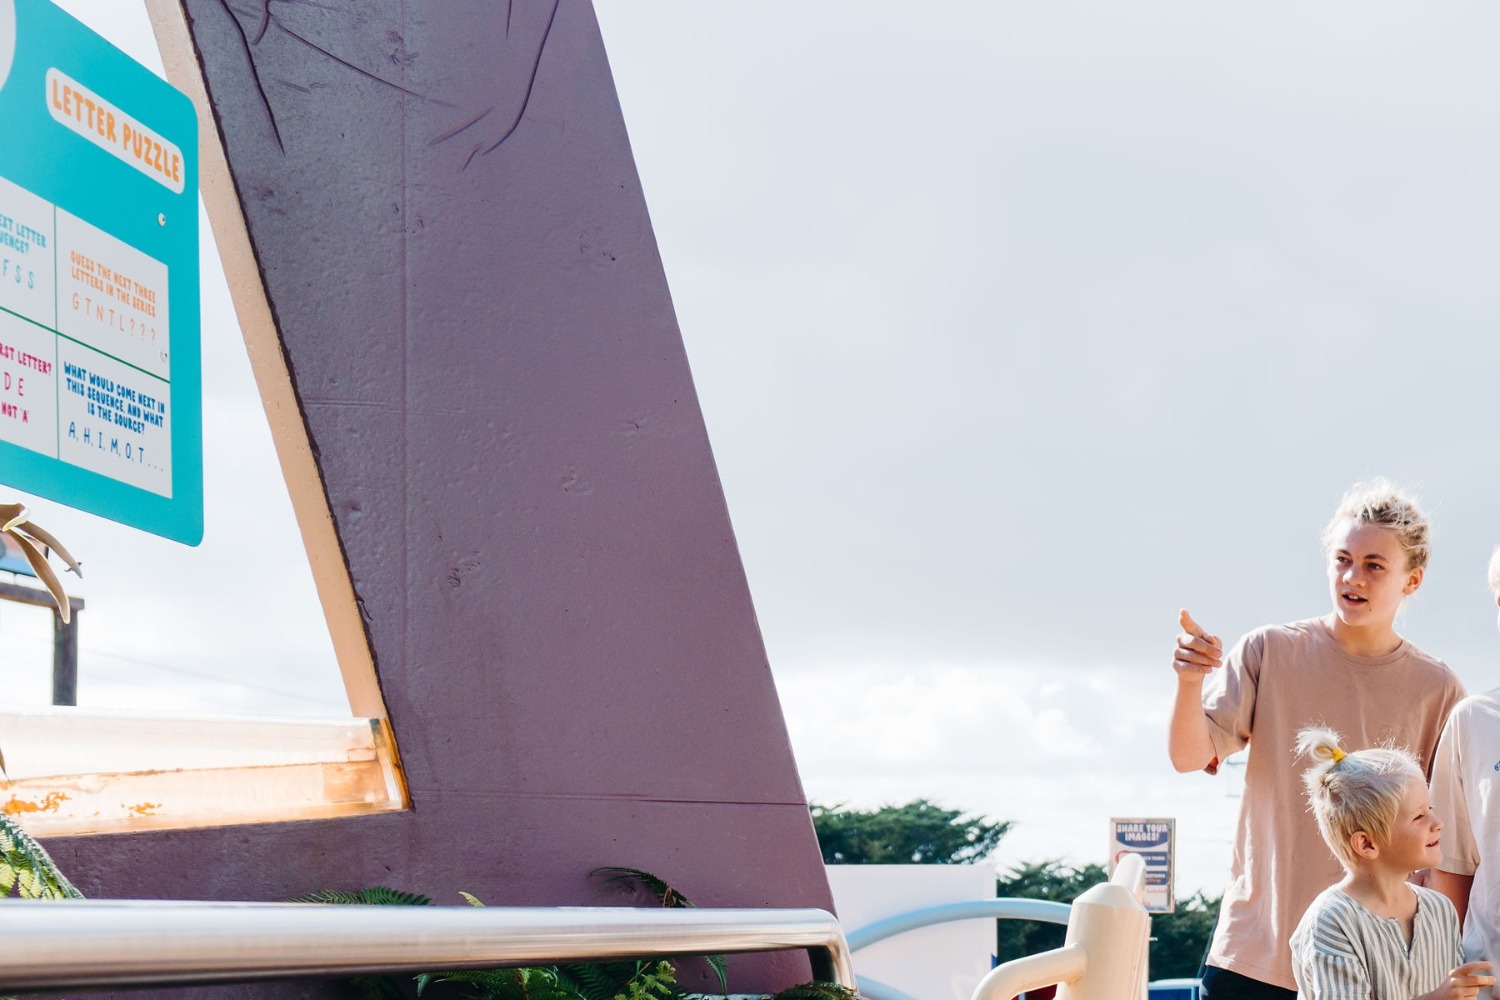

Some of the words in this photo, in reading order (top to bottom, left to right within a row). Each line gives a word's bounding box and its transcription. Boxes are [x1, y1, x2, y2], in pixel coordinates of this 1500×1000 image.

[53, 78, 117, 143] LETTER
[123, 122, 180, 183] PUZZLE
[16, 223, 46, 248] LETTER
[3, 259, 9, 276] F
[15, 264, 21, 283] S
[28, 271, 34, 289] S
[71, 250, 94, 273] GUESS
[97, 262, 111, 281] THE
[114, 272, 131, 291] NEXT
[134, 282, 156, 303] THREE
[72, 265, 103, 292] LETTERS
[106, 282, 114, 297] IN
[116, 287, 130, 305] THE
[133, 296, 156, 318] SERIES
[17, 350, 52, 375] LETTER?
[4, 371, 11, 390] D
[18, 377, 24, 397] E
[64, 361, 86, 381] WHAT
[89, 371, 114, 392] WOULD
[116, 384, 136, 402] COME
[138, 393, 155, 410] NEXT
[158, 401, 165, 414] IN
[1, 401, 17, 419] NOT
[66, 377, 85, 396] THIS
[128, 403, 141, 418] AND
[143, 409, 163, 428] WHAT
[88, 401, 95, 415] IS
[97, 405, 112, 422] THE
[114, 412, 145, 435] SOURCE?
[1117, 824, 1144, 833] SHARE
[1146, 824, 1168, 833] YOUR
[1124, 832, 1160, 841] IMAGES!
